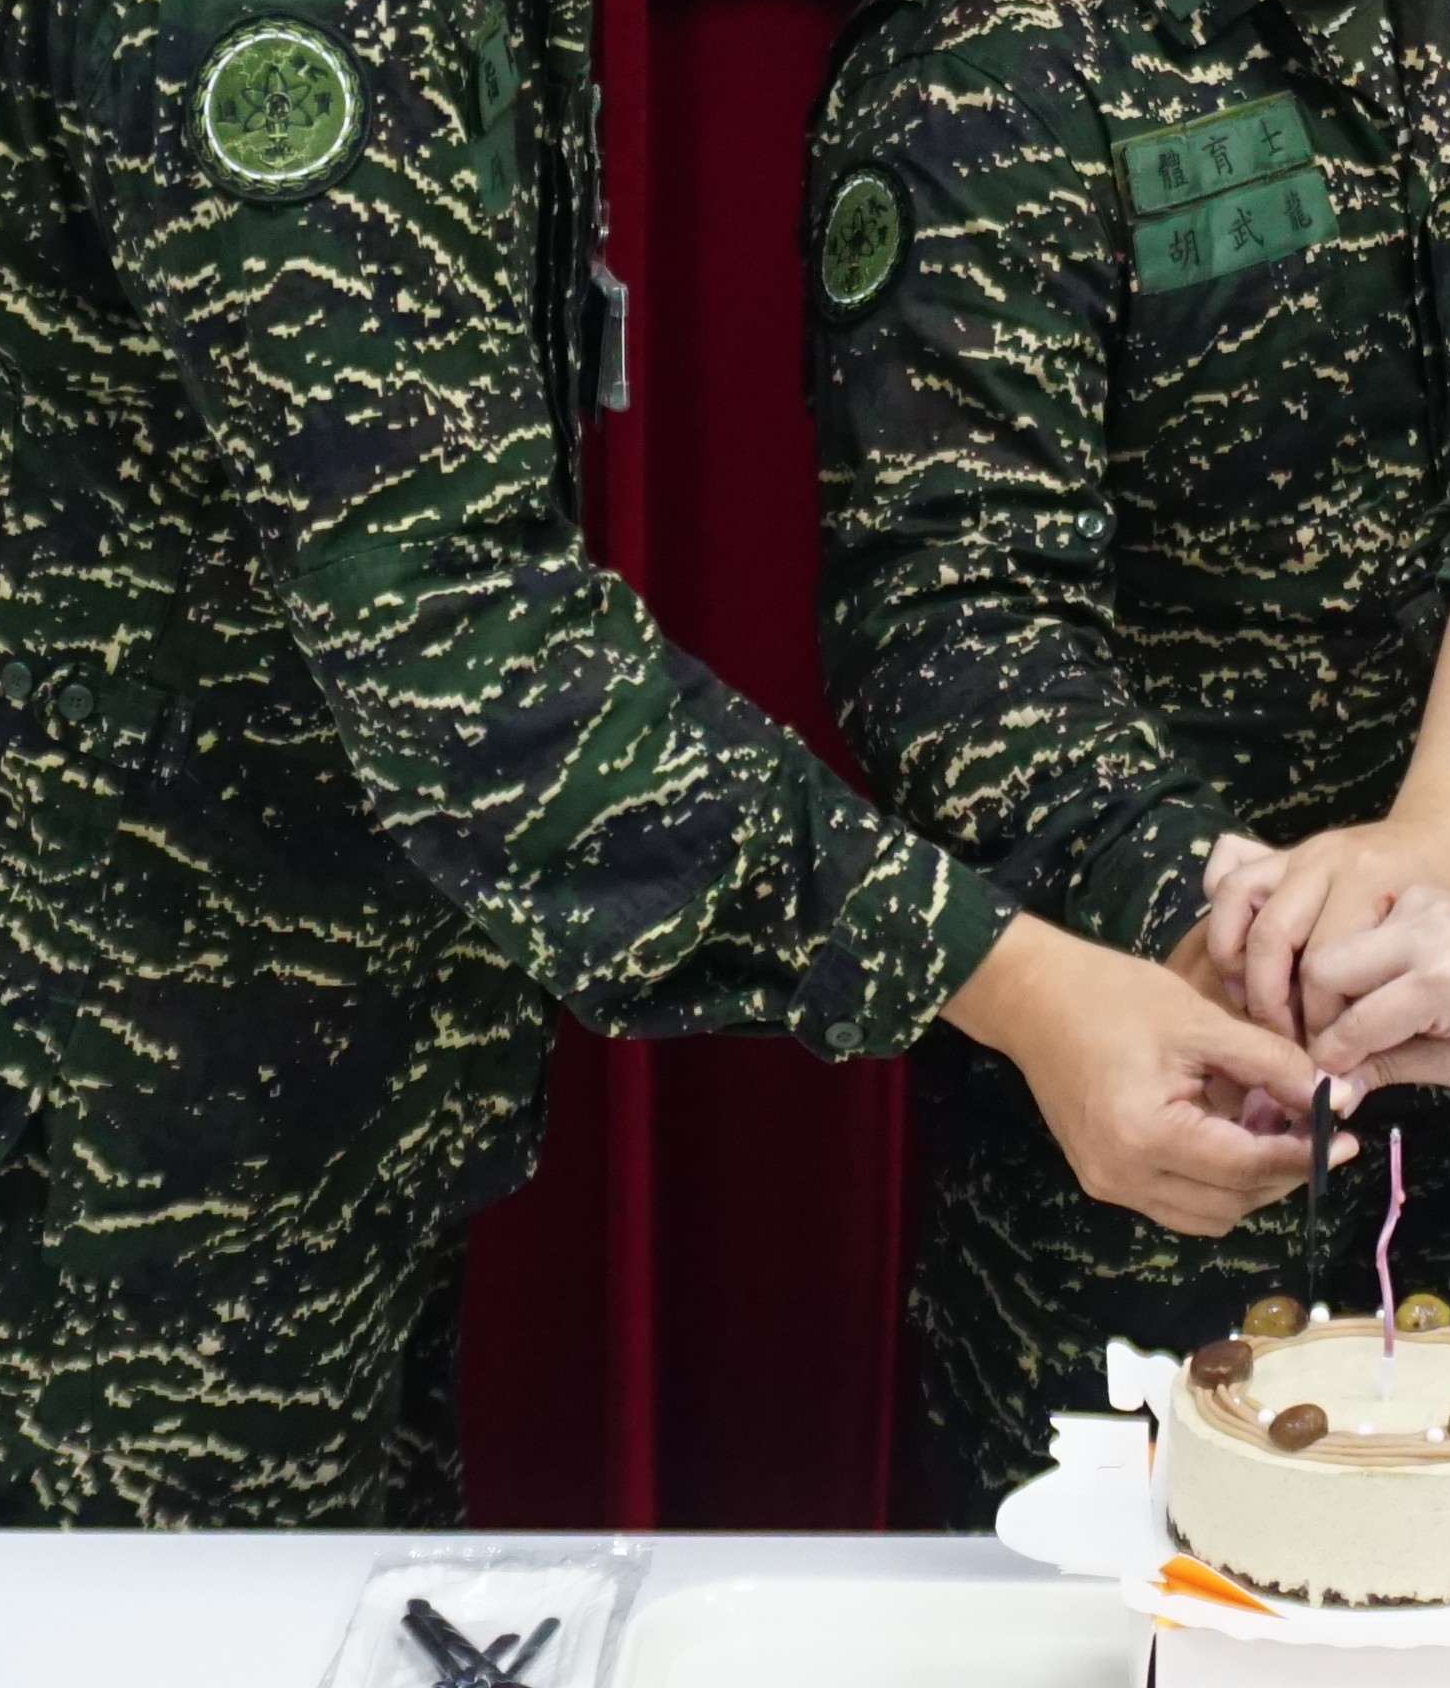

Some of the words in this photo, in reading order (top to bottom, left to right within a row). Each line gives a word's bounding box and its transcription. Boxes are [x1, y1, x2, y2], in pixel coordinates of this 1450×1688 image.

[1157, 120, 1284, 190] 體育士
[1167, 189, 1314, 269] 胡武龍
